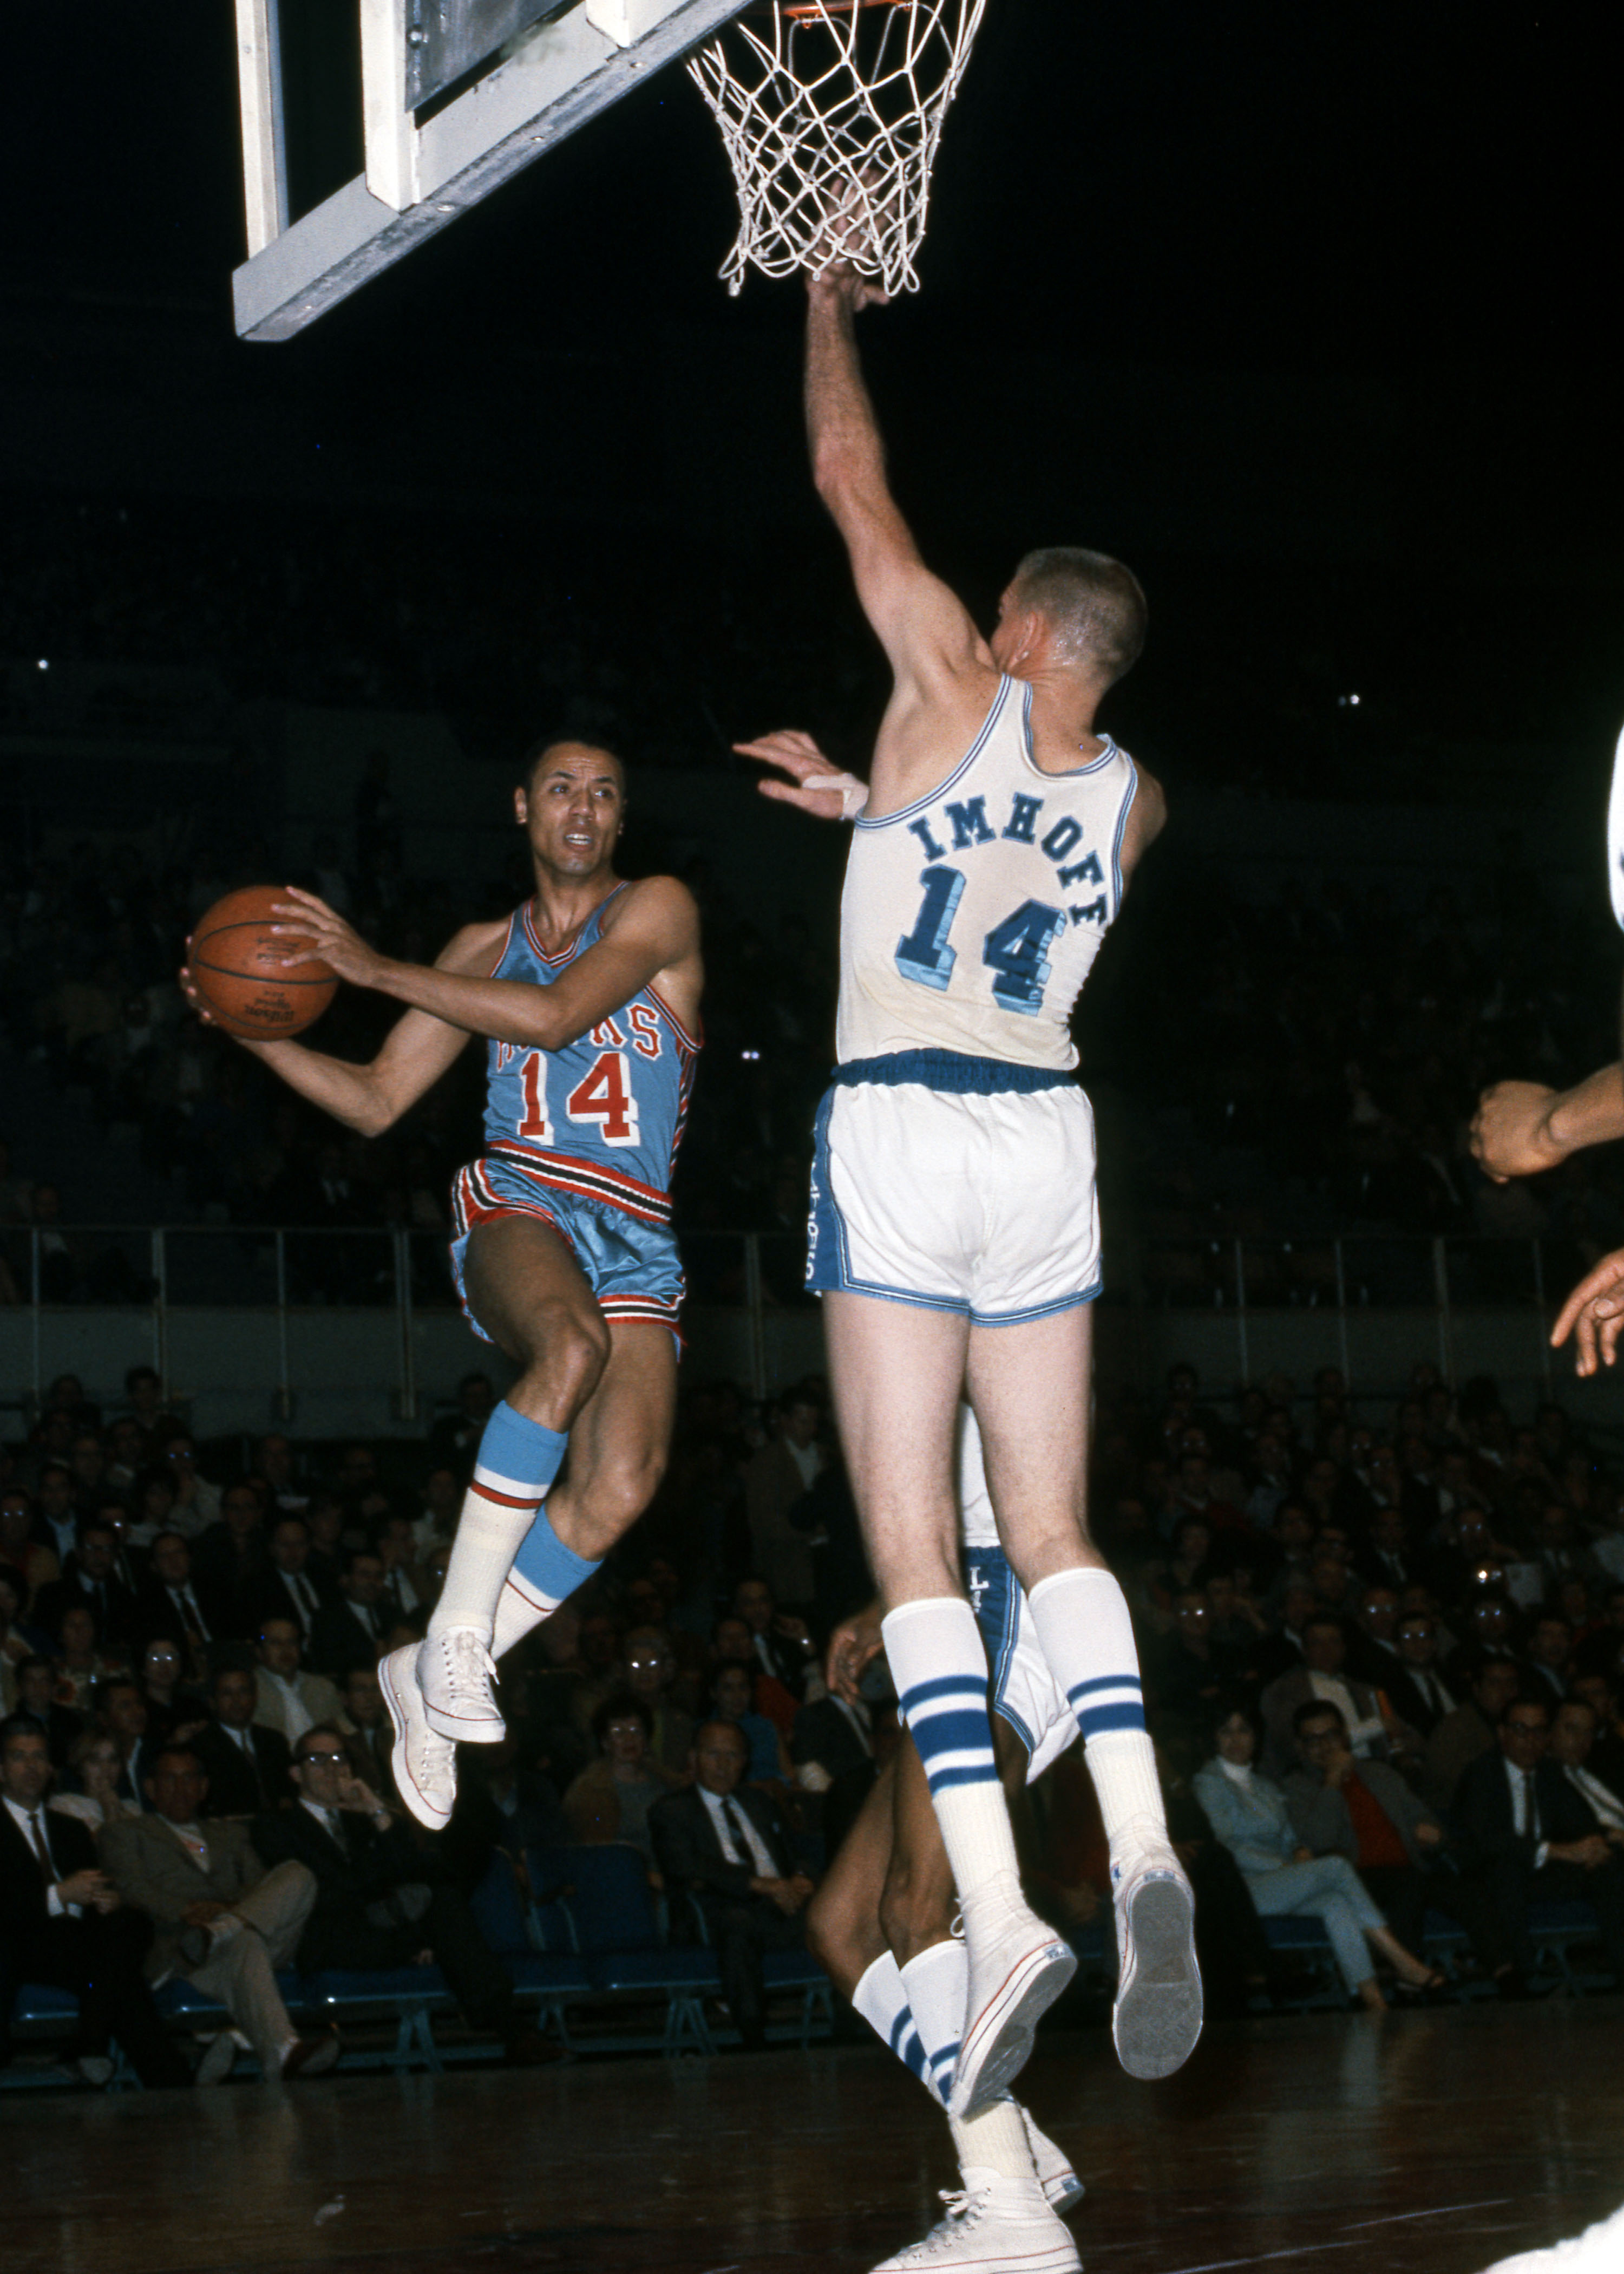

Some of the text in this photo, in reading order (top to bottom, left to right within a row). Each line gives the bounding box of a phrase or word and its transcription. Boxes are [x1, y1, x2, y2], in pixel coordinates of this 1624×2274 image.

[907, 792, 1107, 926] IMHOFF
[894, 863, 1068, 1017] 14
[516, 1051, 641, 1147] 14
